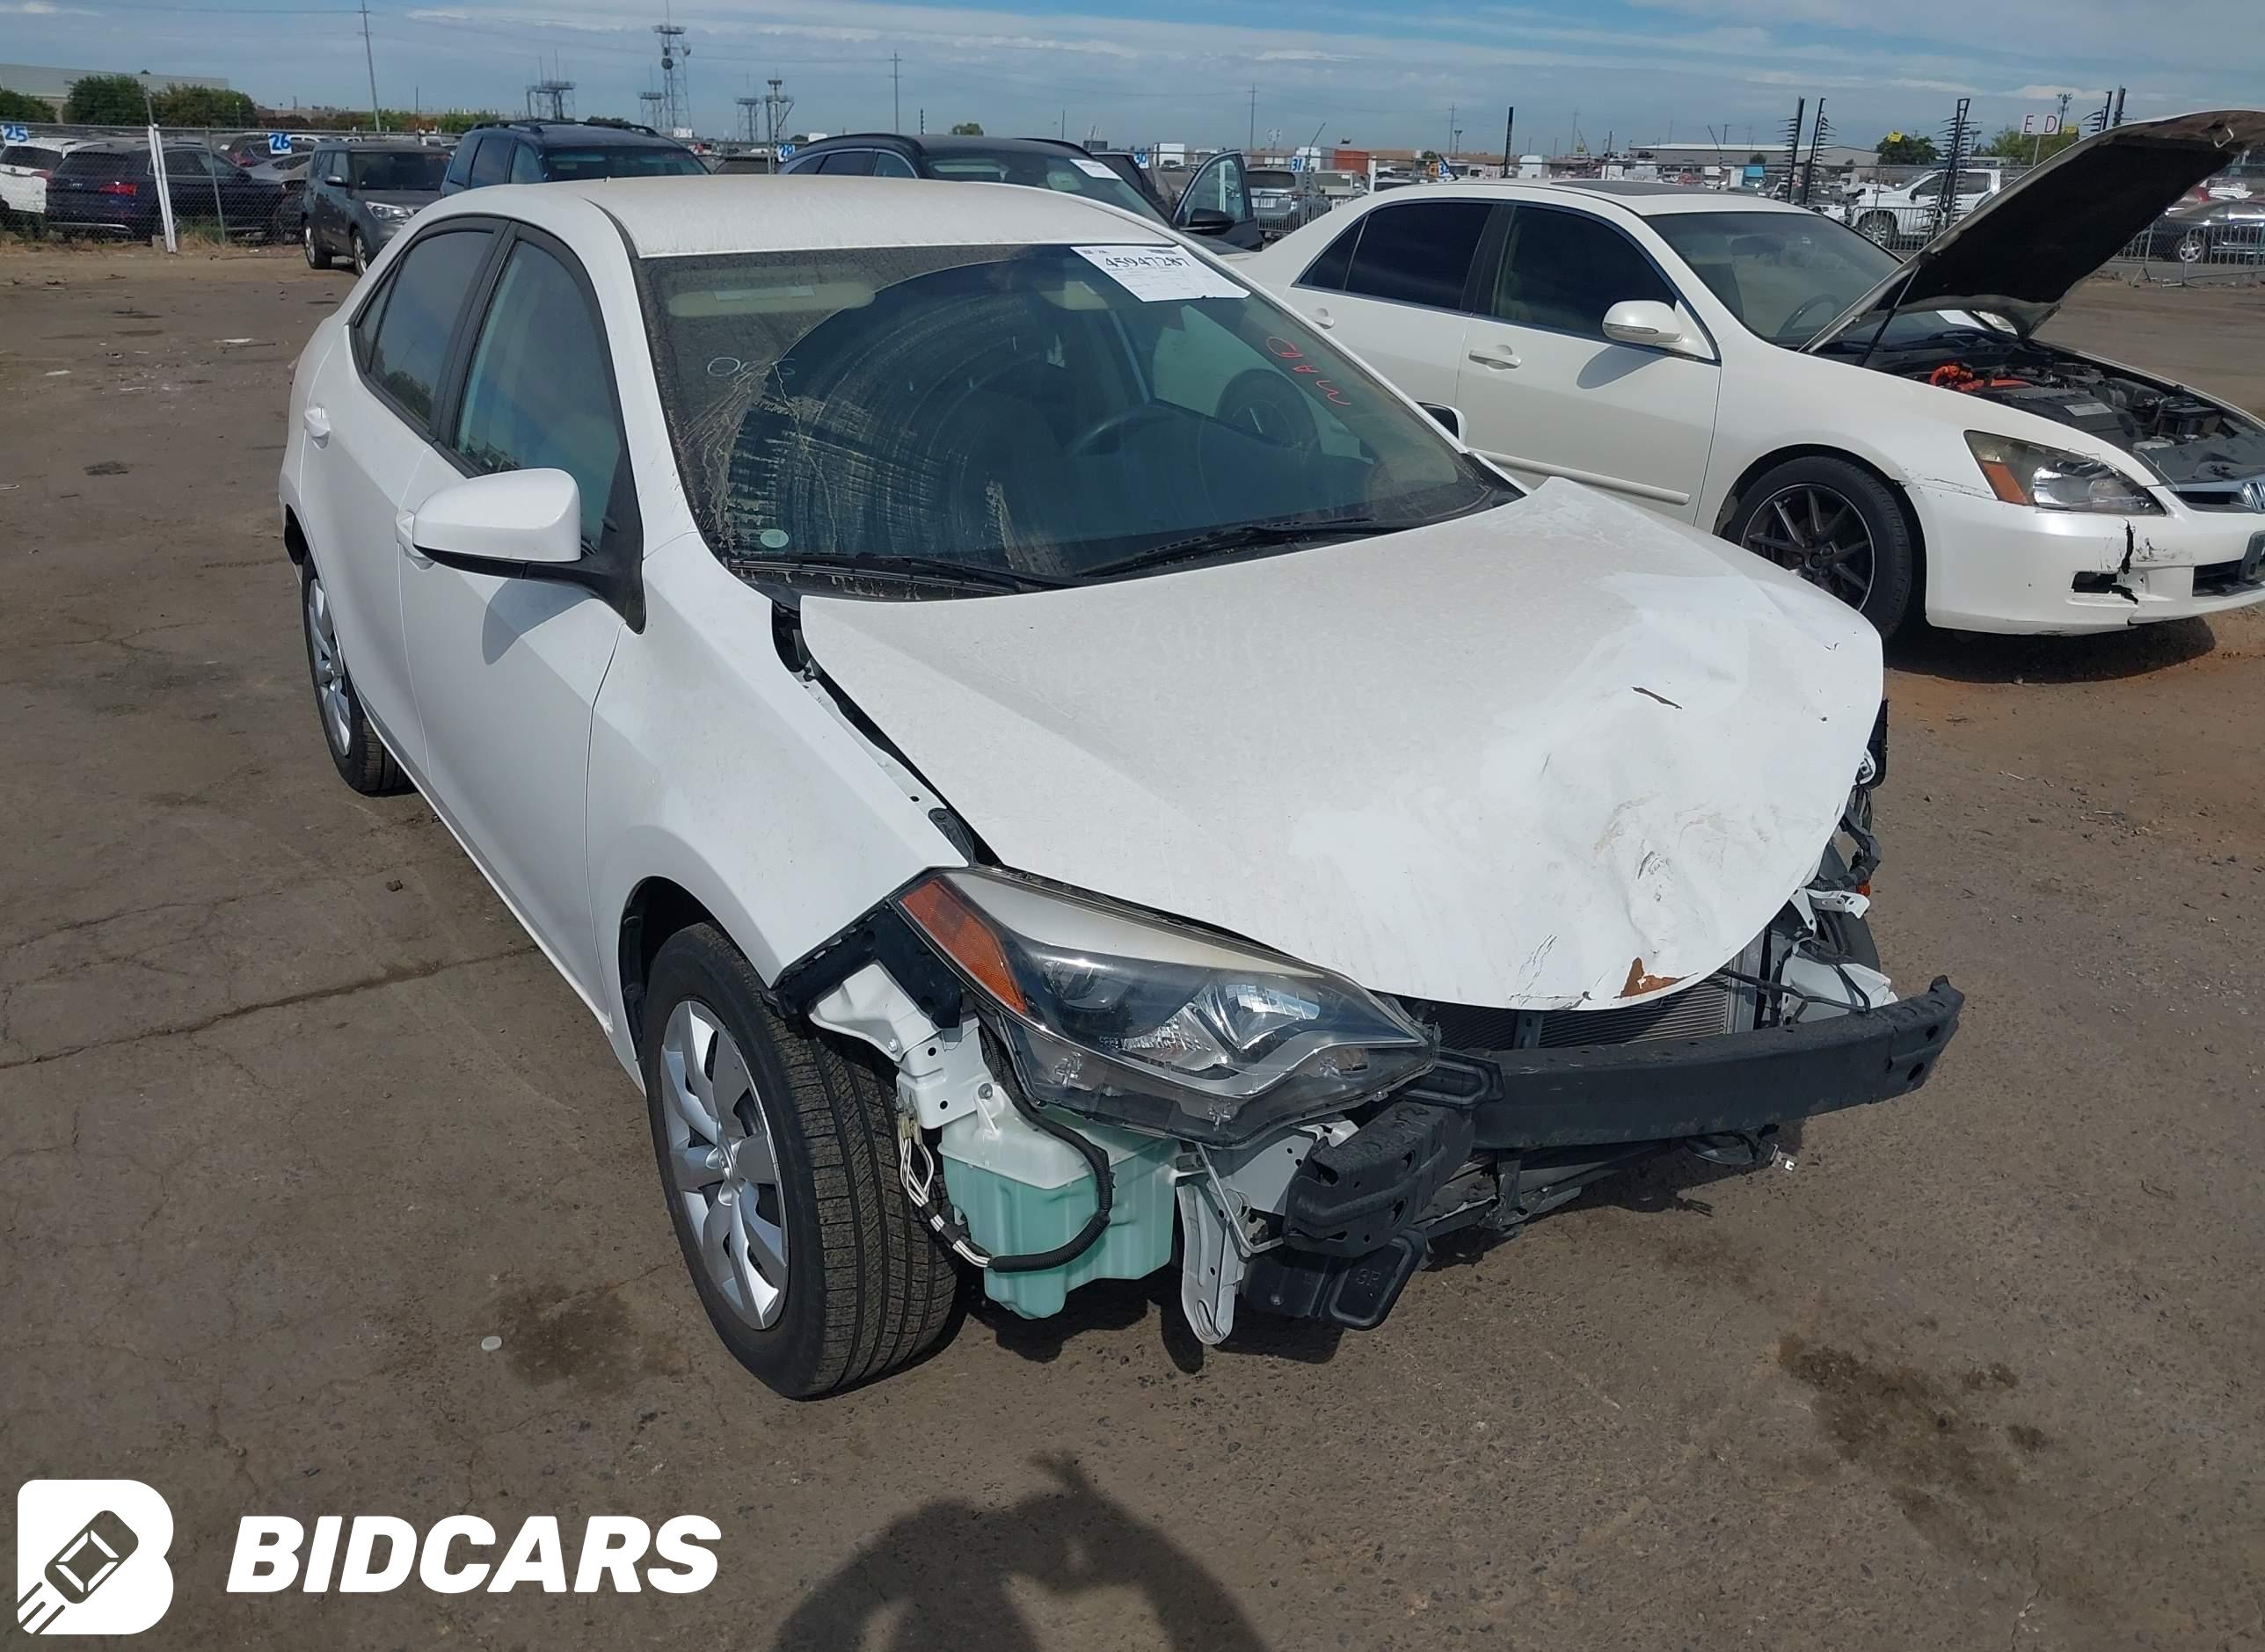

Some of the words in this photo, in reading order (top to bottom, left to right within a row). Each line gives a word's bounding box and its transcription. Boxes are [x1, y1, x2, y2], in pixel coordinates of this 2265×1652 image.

[2024, 115, 2034, 133] E
[2044, 115, 2057, 133] D
[4, 126, 28, 142] 25
[268, 133, 291, 149] 26
[1293, 158, 1303, 171] 31
